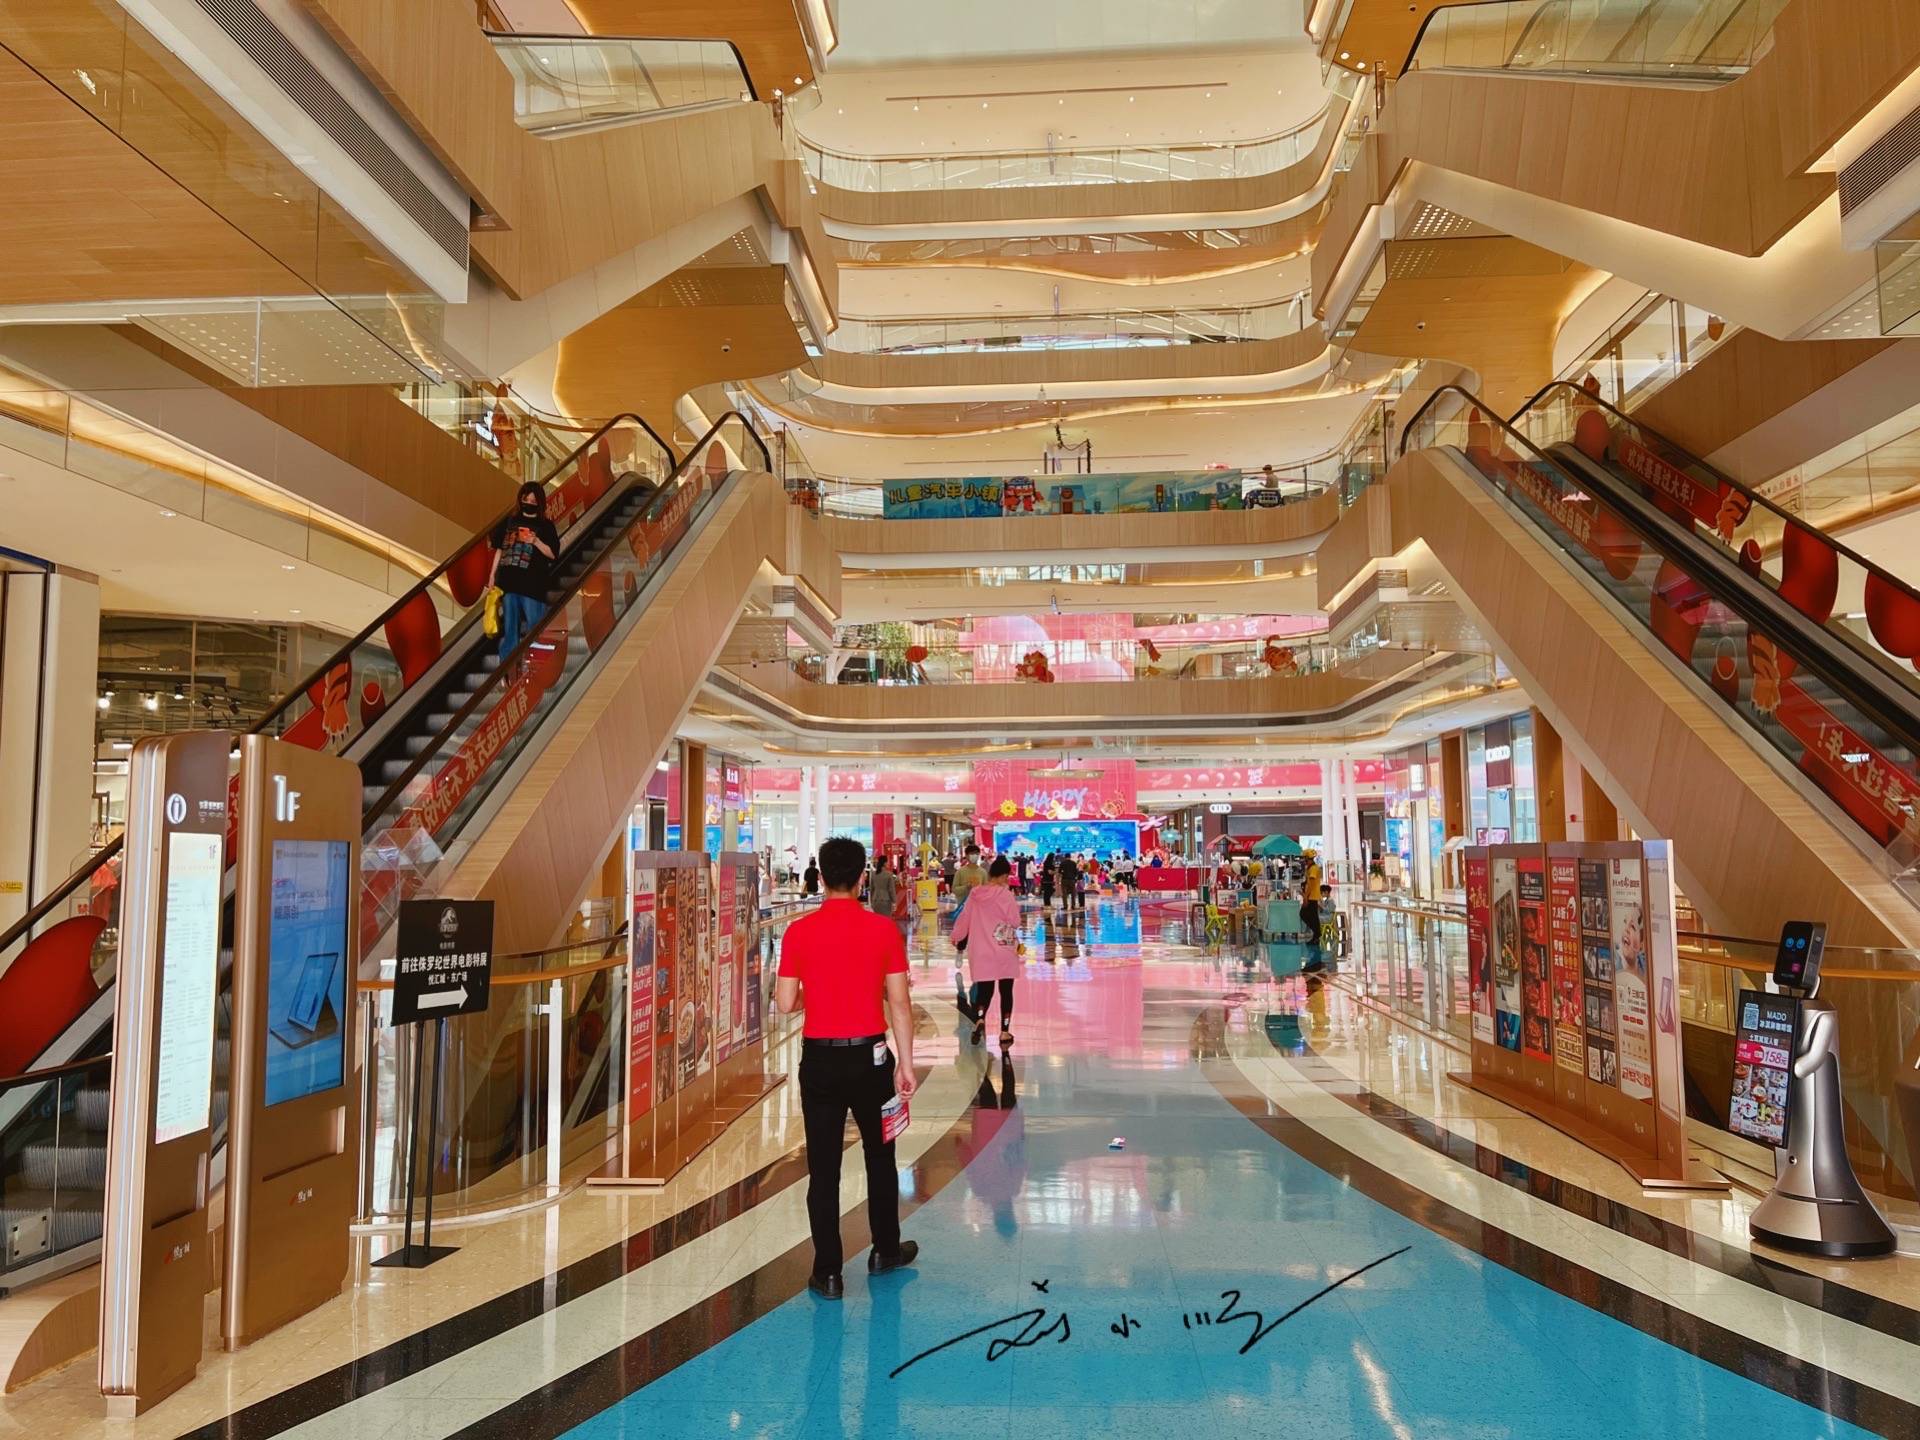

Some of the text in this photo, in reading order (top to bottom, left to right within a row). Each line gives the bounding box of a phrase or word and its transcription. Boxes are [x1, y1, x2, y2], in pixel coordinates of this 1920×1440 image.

[889, 482, 1000, 505] 儿童汽车小镇
[273, 775, 301, 821] 1F
[401, 952, 488, 973] 前往侏罗纪世界电影特展
[1766, 1010, 1787, 1021] MADO
